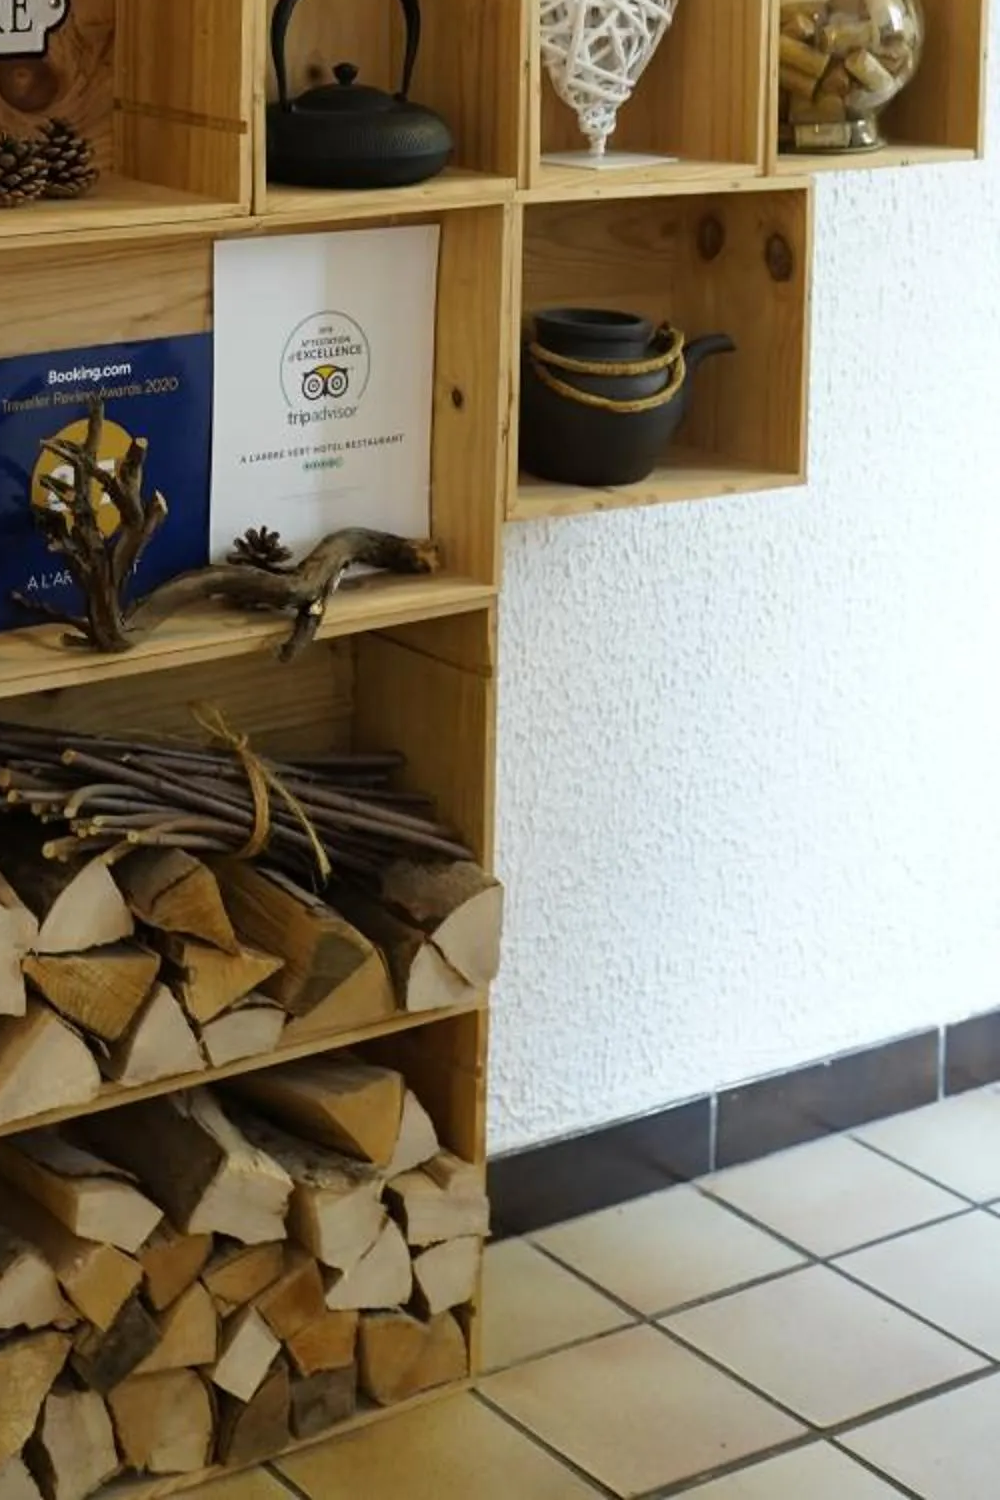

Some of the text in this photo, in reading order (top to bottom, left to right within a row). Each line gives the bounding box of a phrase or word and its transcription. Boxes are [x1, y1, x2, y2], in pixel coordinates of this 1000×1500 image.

[47, 362, 132, 385] Booking.com
[99, 384, 142, 400] Awards
[145, 377, 179, 393] 2020
[287, 405, 359, 427] tripadvisor
[239, 455, 247, 464] A
[345, 433, 406, 450] RESTAURANT
[26, 574, 39, 591] A
